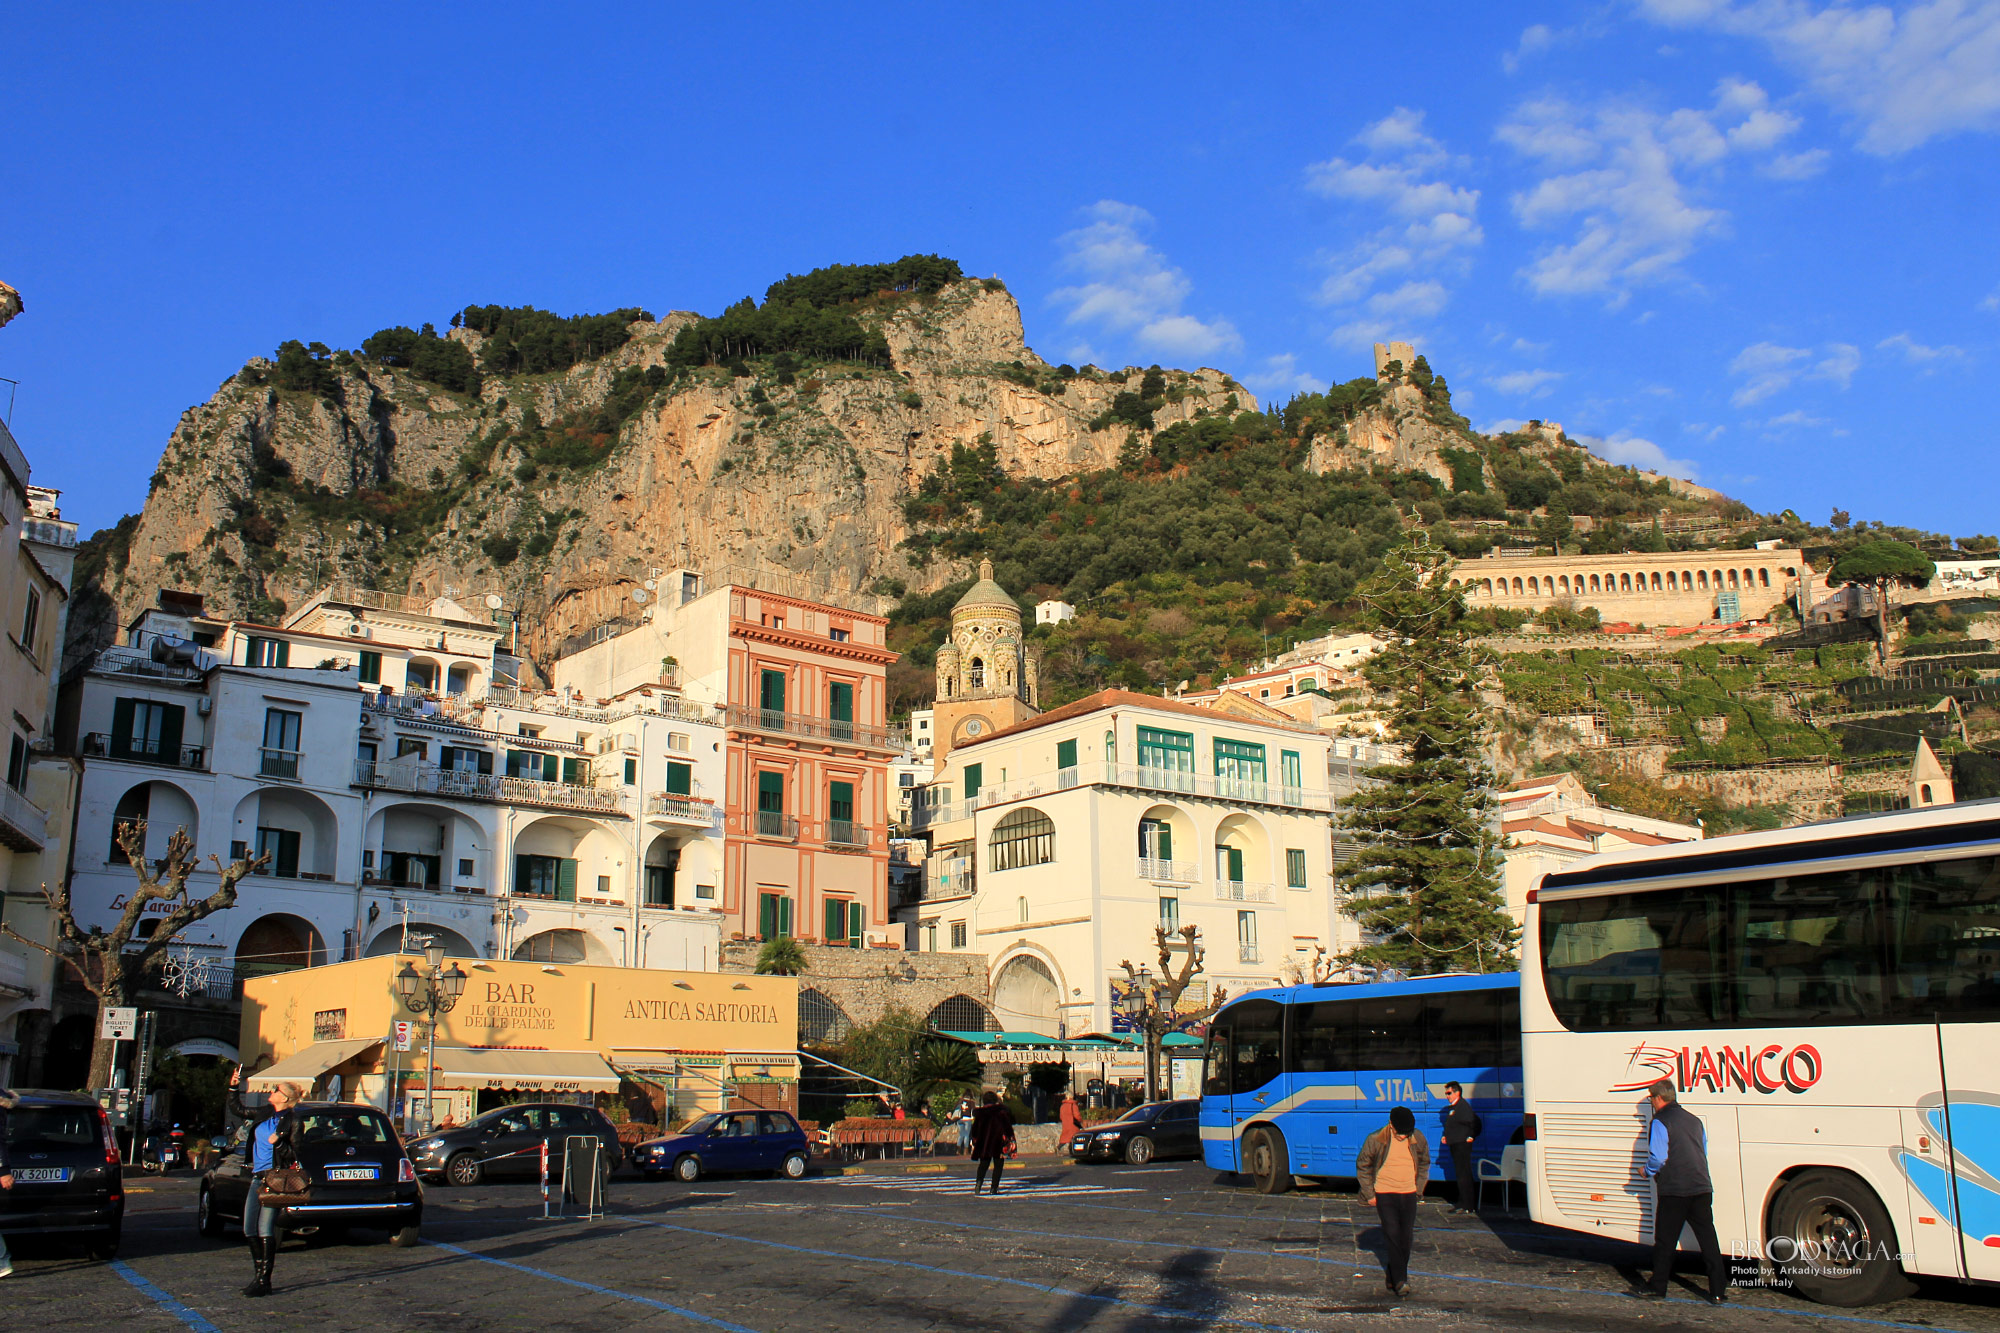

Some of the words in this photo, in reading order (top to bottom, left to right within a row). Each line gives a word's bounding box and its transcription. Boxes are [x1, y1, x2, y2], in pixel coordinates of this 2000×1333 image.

[485, 982, 536, 1004] BAR
[471, 1004, 484, 1016] IL
[487, 1005, 551, 1018] GIARDINO
[624, 999, 691, 1021] ANTICA
[695, 1001, 779, 1024] SARTORIA
[465, 1016, 508, 1028] DELLE
[512, 1018, 555, 1030] PALME
[990, 1051, 1051, 1062] GELATERIA
[1096, 1053, 1117, 1062] BAR
[1609, 1041, 1822, 1094] BIANCO
[1374, 1078, 1415, 1102] SITA
[12, 1169, 25, 1180] DK
[28, 1168, 61, 1180] 320YC
[333, 1170, 345, 1179] EN
